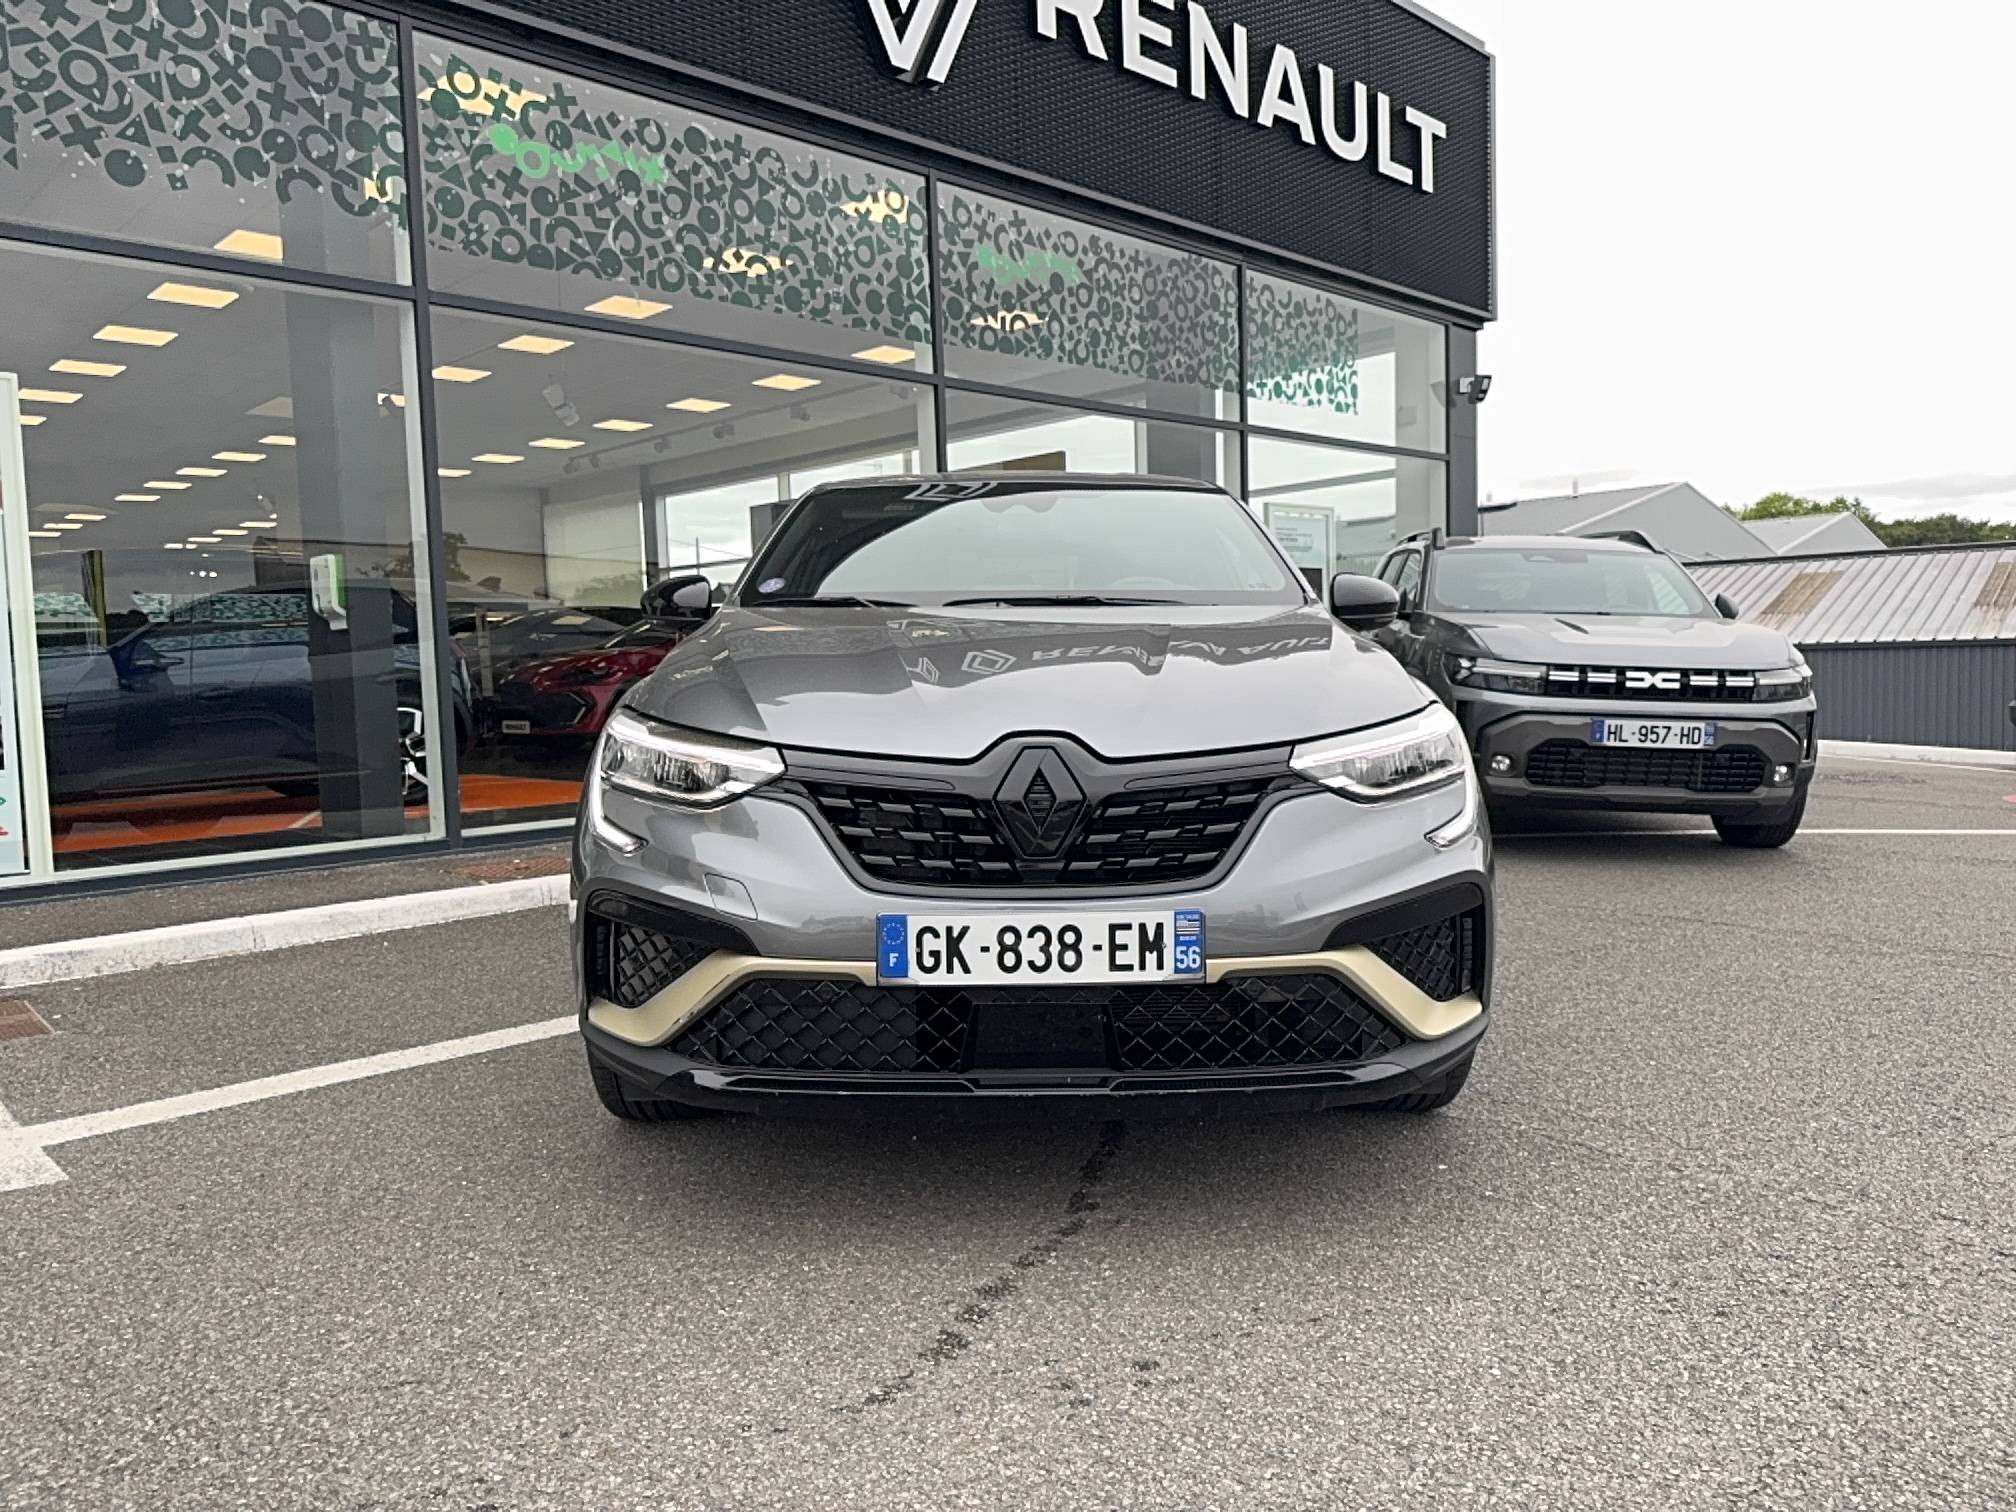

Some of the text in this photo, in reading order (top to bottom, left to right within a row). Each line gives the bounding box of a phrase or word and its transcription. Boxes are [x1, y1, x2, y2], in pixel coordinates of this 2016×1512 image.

[1607, 724, 1702, 745] HL-957-HD
[915, 922, 1165, 975] GK-838-EM
[1175, 946, 1201, 969] 56
[889, 953, 898, 967] F
